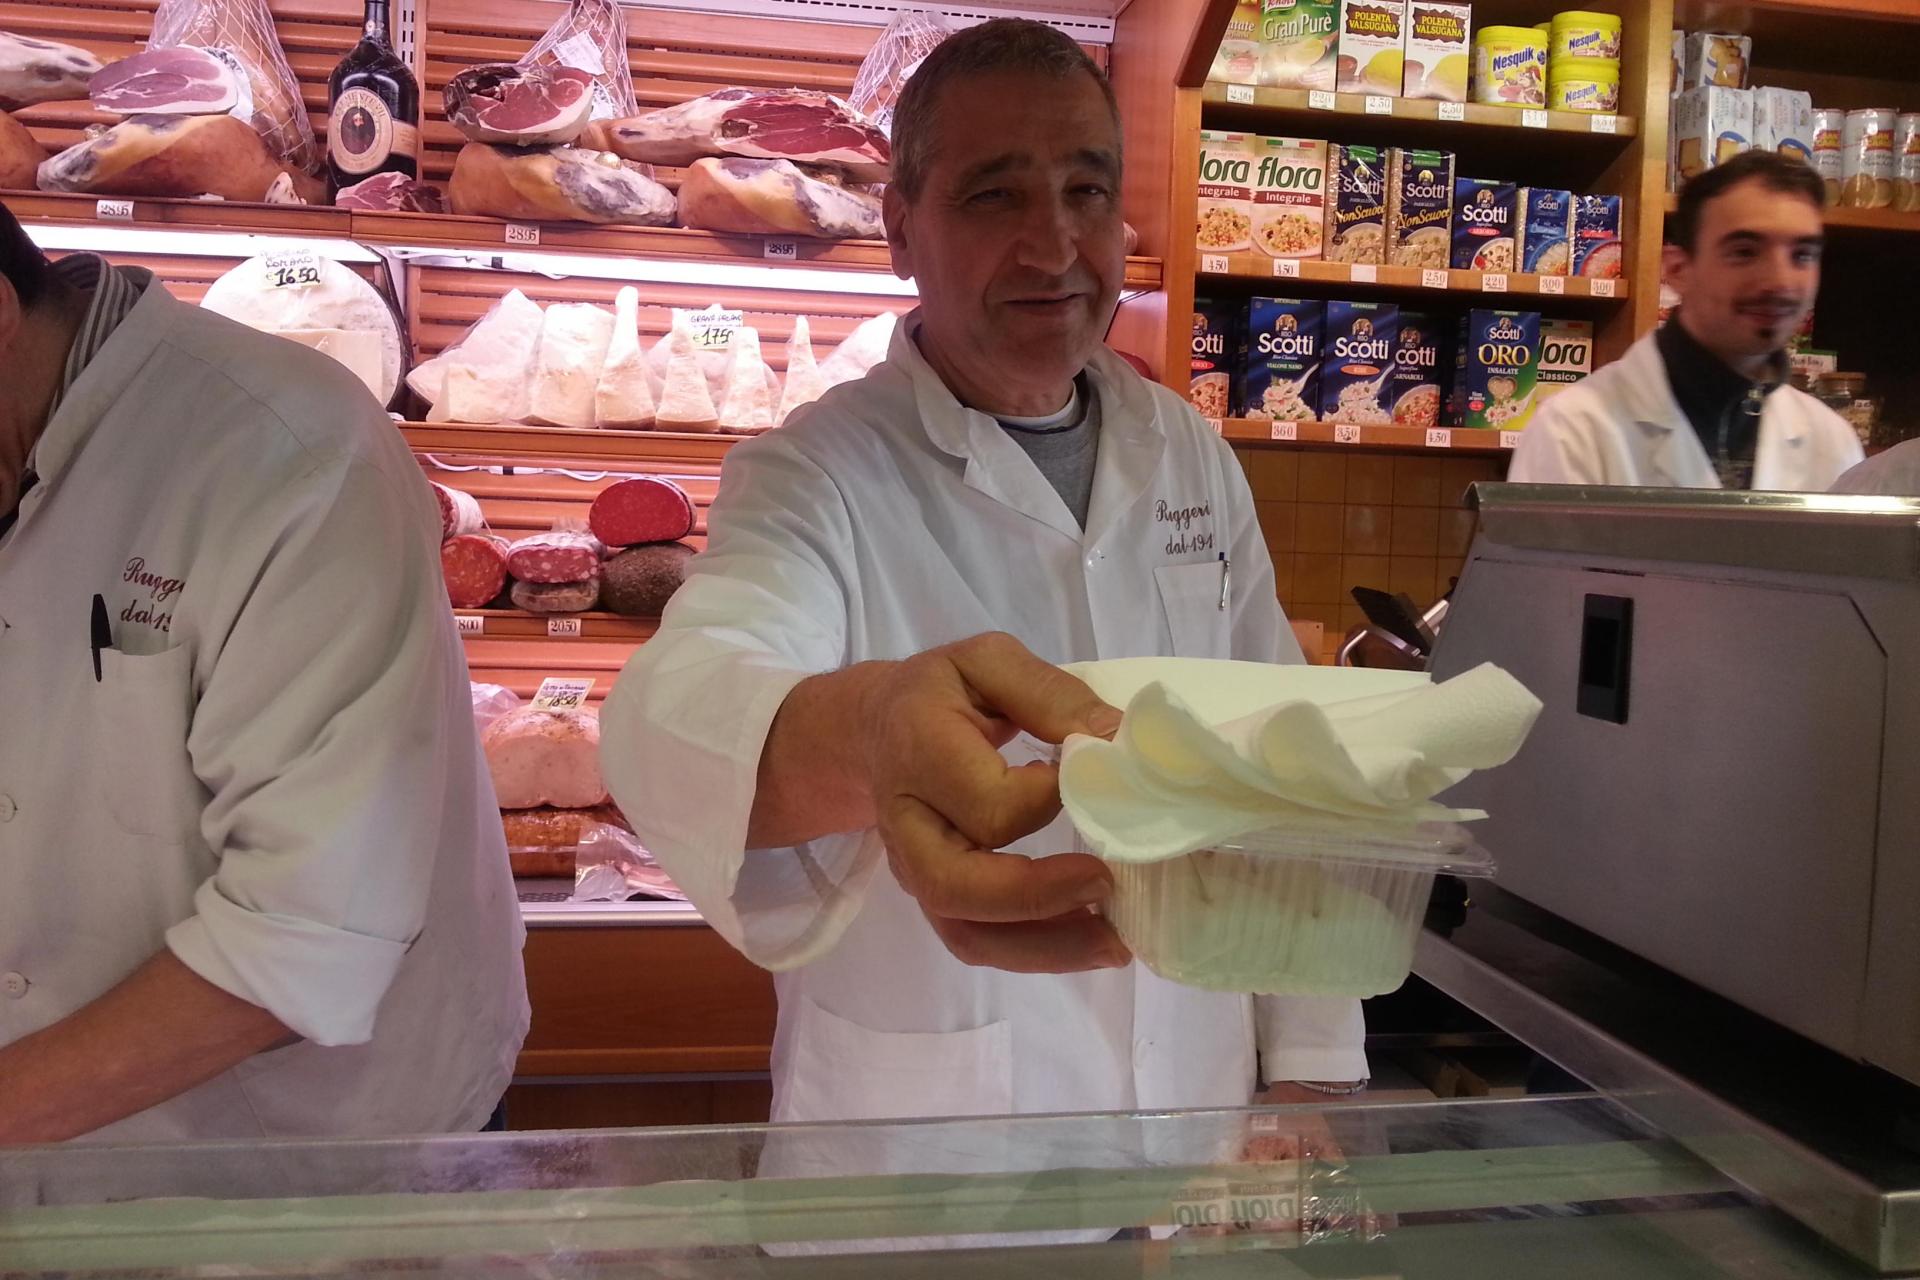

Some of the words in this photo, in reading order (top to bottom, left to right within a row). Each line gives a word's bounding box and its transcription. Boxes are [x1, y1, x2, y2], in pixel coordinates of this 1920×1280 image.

[1355, 11, 1391, 23] POLENTA
[1422, 15, 1457, 28] POLENTA
[1349, 20, 1397, 33] VALSUGANA
[1416, 24, 1463, 38] VALSUGANA
[1569, 31, 1600, 50] Nesquik
[1493, 47, 1534, 72] Nesquik
[1565, 84, 1597, 103] Nesquik
[1199, 150, 1250, 183] lora
[1257, 156, 1322, 190] flora
[1198, 187, 1240, 199] ntegrale
[1343, 179, 1380, 195] Scotti
[1406, 183, 1445, 199] Scotti
[1266, 192, 1312, 205] Integrale
[1537, 199, 1559, 211] Scotti
[1462, 204, 1508, 224] Scotti
[1489, 327, 1520, 341] Scotti
[1192, 333, 1224, 354] otti
[1257, 332, 1314, 356] Scotti
[1334, 336, 1389, 360] Scotti
[1538, 335, 1587, 366] lora
[1395, 346, 1436, 367] cotti
[1478, 343, 1530, 366] ORO
[1394, 373, 1424, 381] ARNAROLI
[1487, 367, 1519, 376] INSALATE
[1537, 370, 1577, 381] Classico
[1155, 498, 1211, 531] Ruggeri
